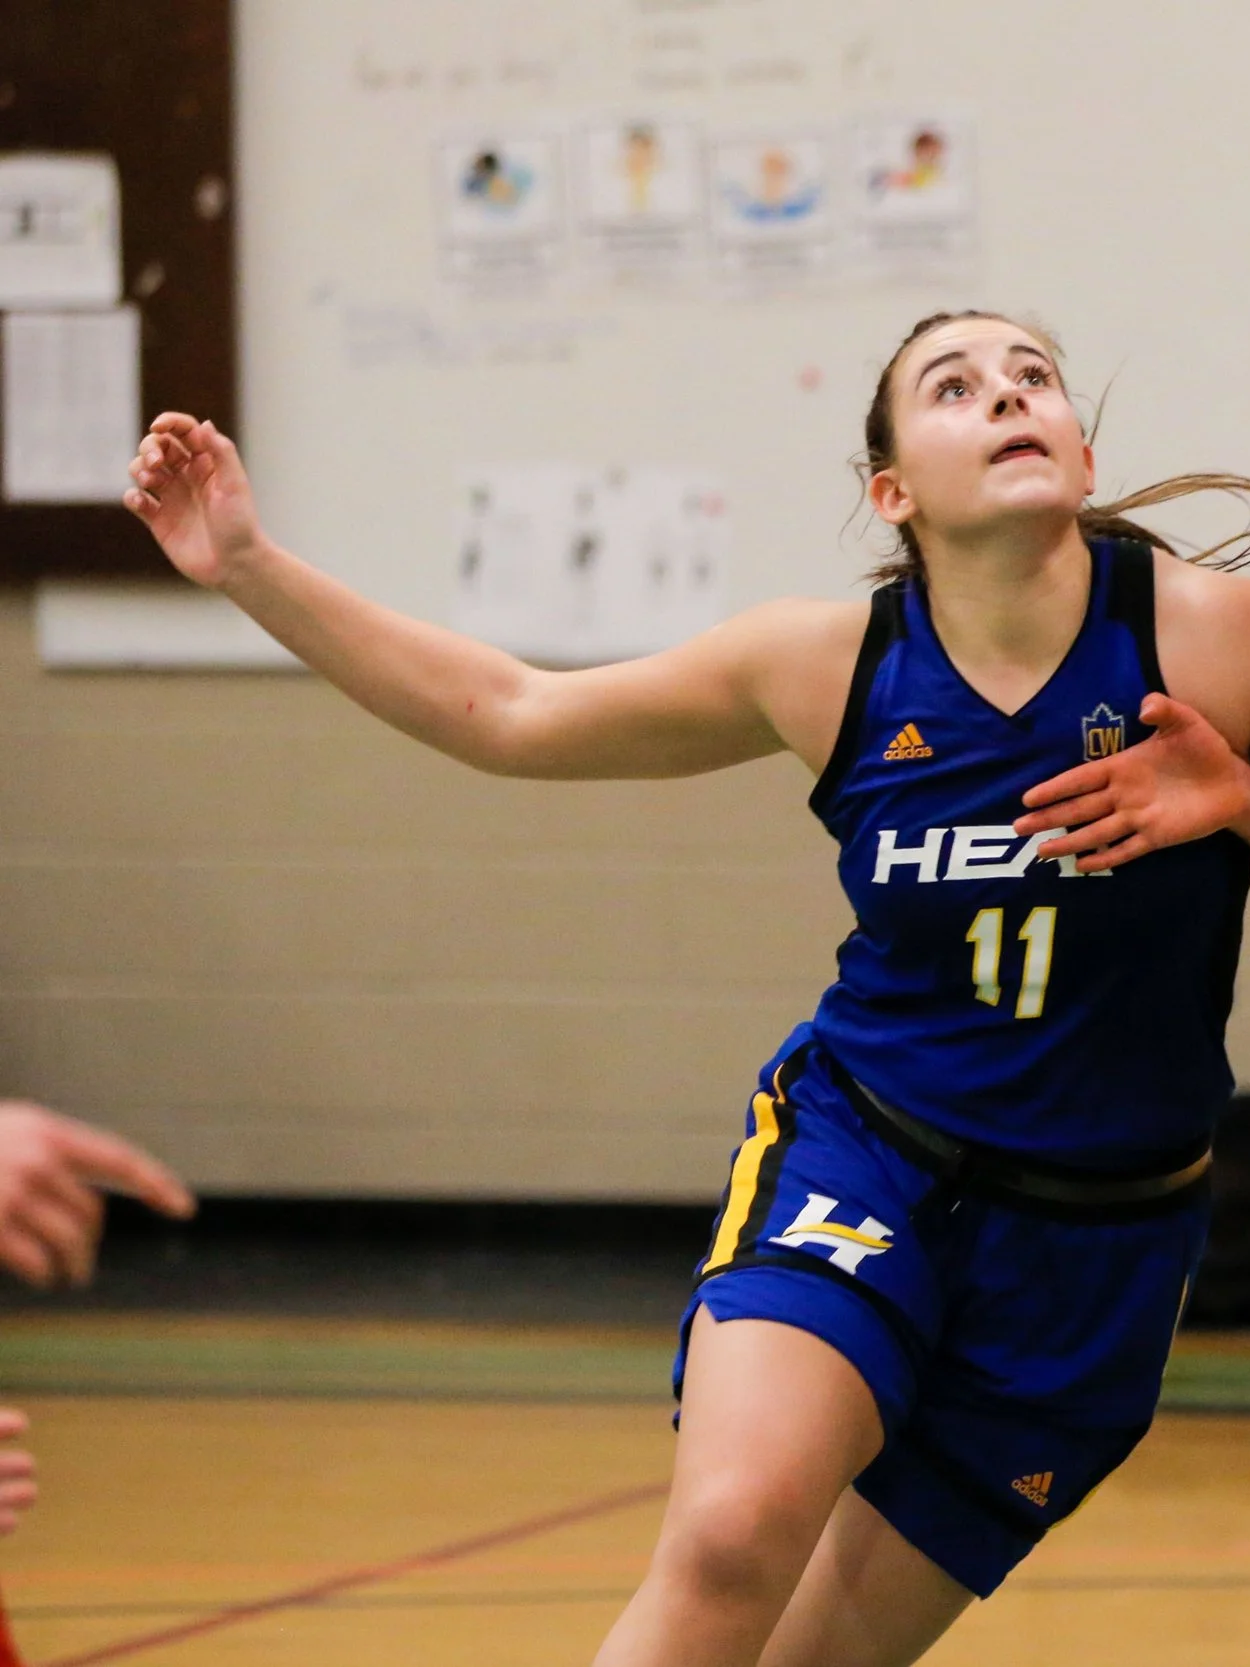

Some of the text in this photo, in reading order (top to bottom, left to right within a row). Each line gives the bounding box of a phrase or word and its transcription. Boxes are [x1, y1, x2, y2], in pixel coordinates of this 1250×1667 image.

[883, 745, 933, 760] adidas
[1088, 727, 1120, 757] CW
[871, 825, 1113, 884] HEA
[965, 906, 1057, 1019] 11
[1010, 1478, 1049, 1507] adidas
